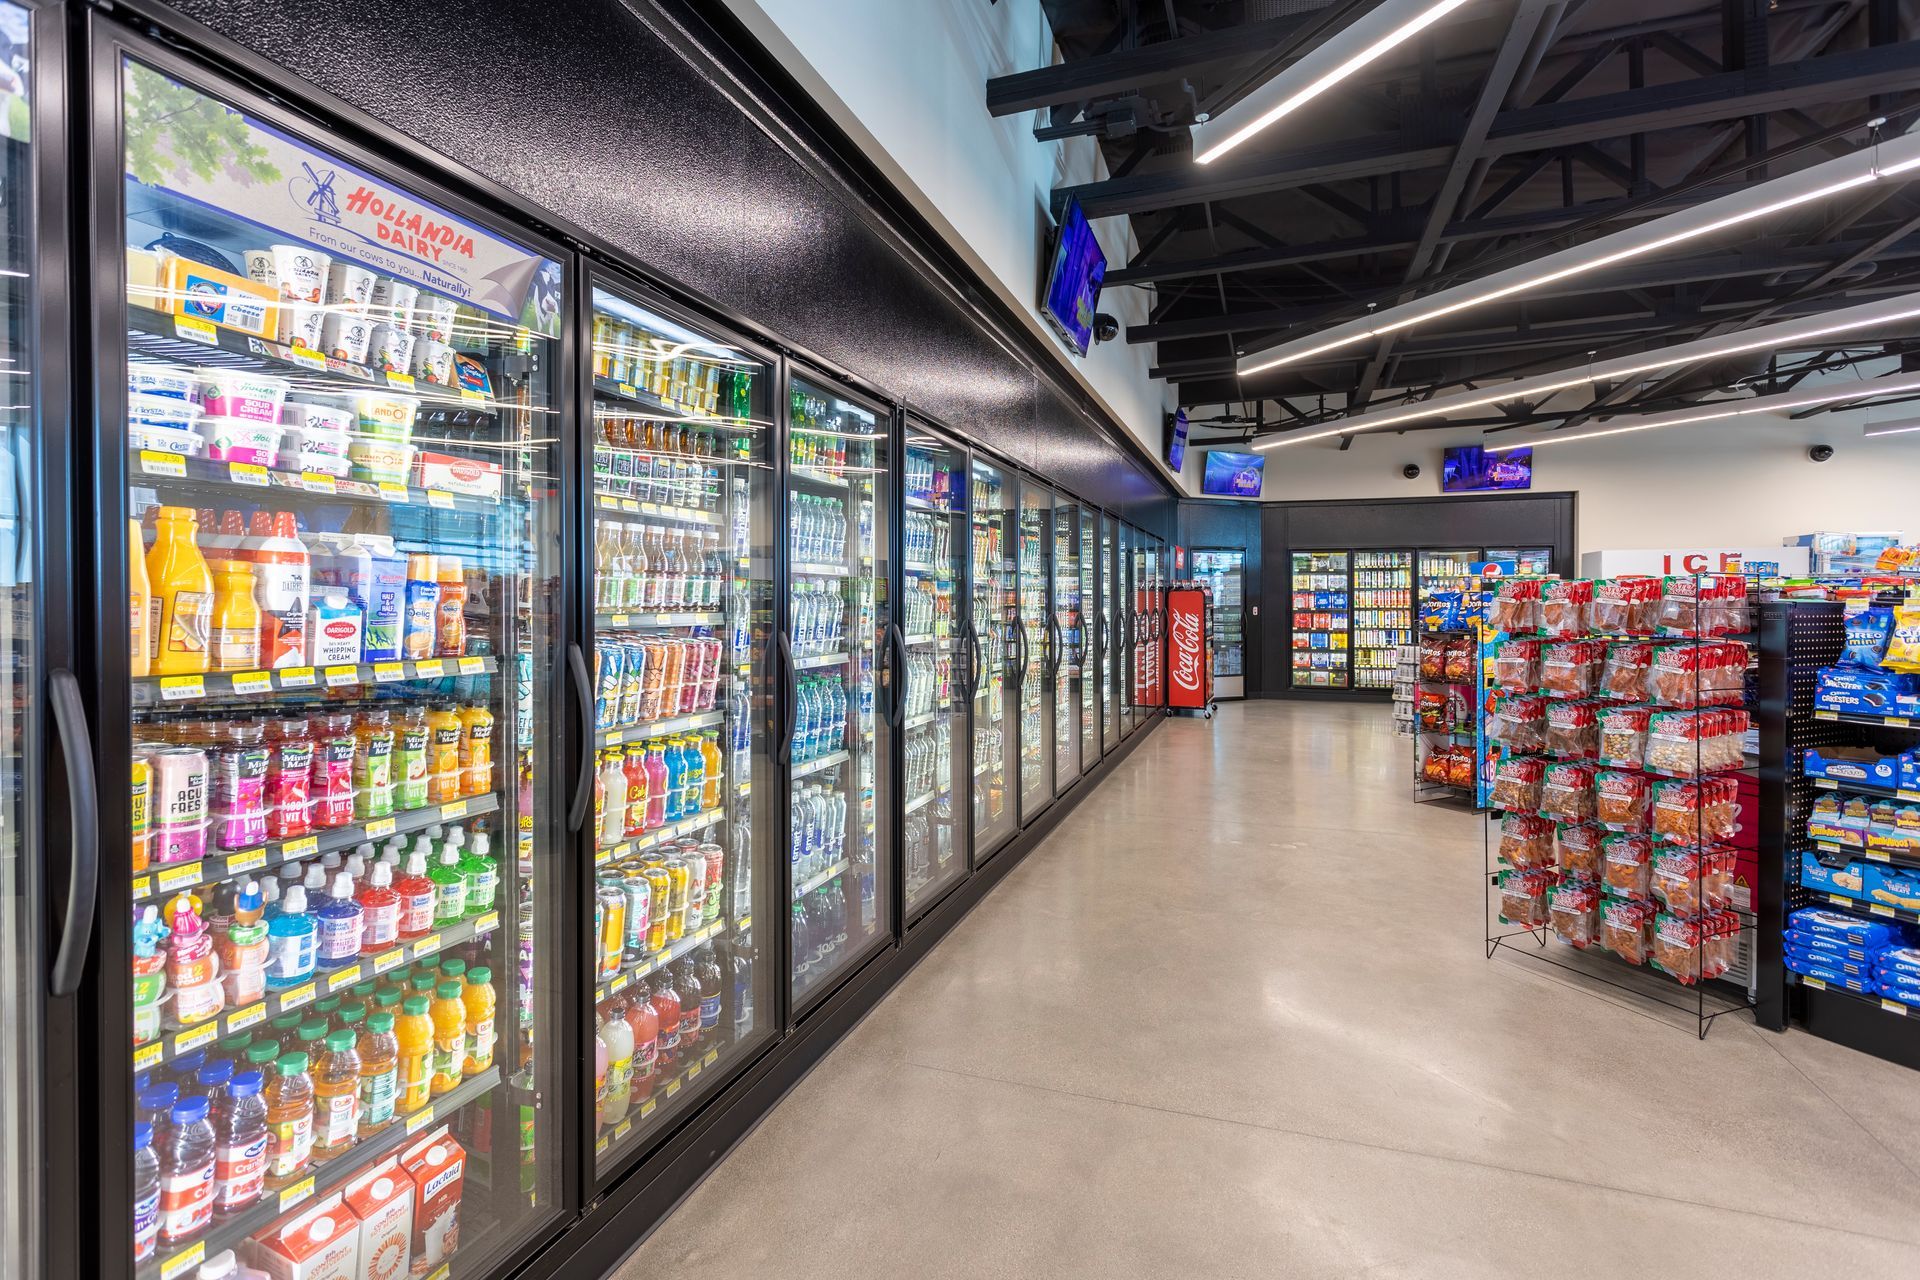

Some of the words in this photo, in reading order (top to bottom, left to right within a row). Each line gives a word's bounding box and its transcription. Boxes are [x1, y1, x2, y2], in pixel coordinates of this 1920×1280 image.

[345, 186, 474, 258] HOLLANDIA
[376, 222, 443, 262] DAIRY
[309, 226, 336, 247] From
[340, 240, 356, 254] our
[360, 249, 384, 266] cows
[386, 256, 396, 270] to
[231, 306, 260, 318] Cheese
[244, 399, 270, 410] SOUR
[240, 405, 273, 417] CREAM
[374, 408, 392, 416] AND
[381, 592, 394, 601] HALF
[407, 608, 430, 619] Delig
[326, 626, 355, 634] DARIGOLD
[1895, 629, 1920, 638] OR
[1846, 632, 1882, 640] OREO
[1172, 608, 1199, 690] Coca-Cola
[1822, 694, 1859, 704] CAKESTERS
[284, 754, 311, 762] Minu
[178, 788, 202, 802] AGU
[171, 799, 201, 814] FRES
[334, 802, 345, 812] VIT
[347, 801, 352, 810] C
[286, 812, 301, 823] VIT
[1868, 834, 1908, 848] Dunkaroos
[1812, 941, 1837, 949] OREO
[1808, 954, 1833, 963] OREO
[1810, 970, 1835, 979] OREO
[425, 1162, 461, 1196] Lactaid
[373, 1204, 406, 1230] CONTINENT
